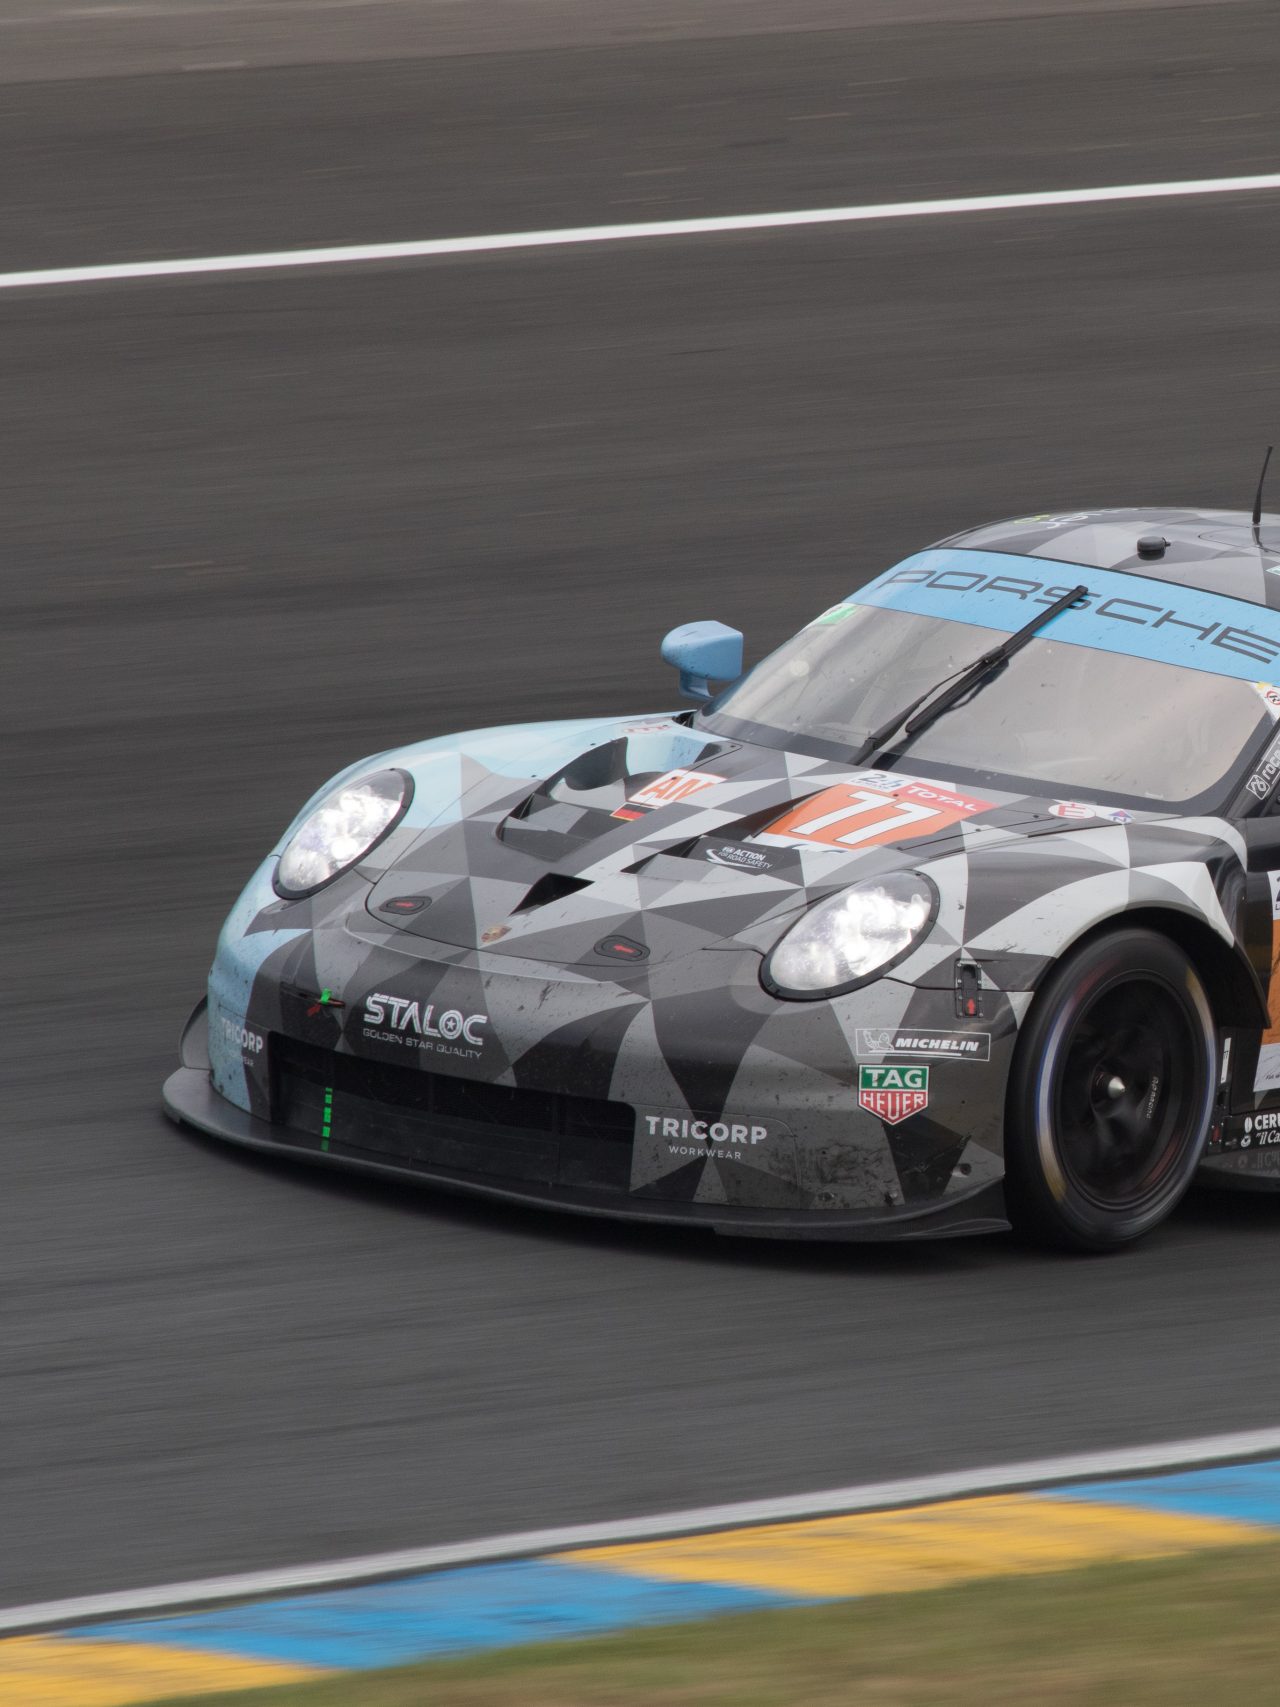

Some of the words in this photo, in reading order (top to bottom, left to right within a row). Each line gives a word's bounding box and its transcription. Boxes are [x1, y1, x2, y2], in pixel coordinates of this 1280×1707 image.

[906, 786, 978, 811] TOTAL
[790, 791, 943, 845] 77
[727, 854, 747, 863] ROAD
[746, 859, 774, 869] SAFETY
[733, 849, 766, 861] ACTION
[364, 993, 488, 1045] STALOC
[363, 1028, 403, 1044] GOLDEN
[405, 1037, 433, 1051] STAR
[436, 1043, 482, 1059] QUALITY
[895, 1038, 979, 1052] MICHELIN
[865, 1069, 922, 1088] TAG
[863, 1092, 924, 1120] HEUER
[645, 1115, 767, 1145] TRICORP
[668, 1145, 742, 1160] WORKWEAR
